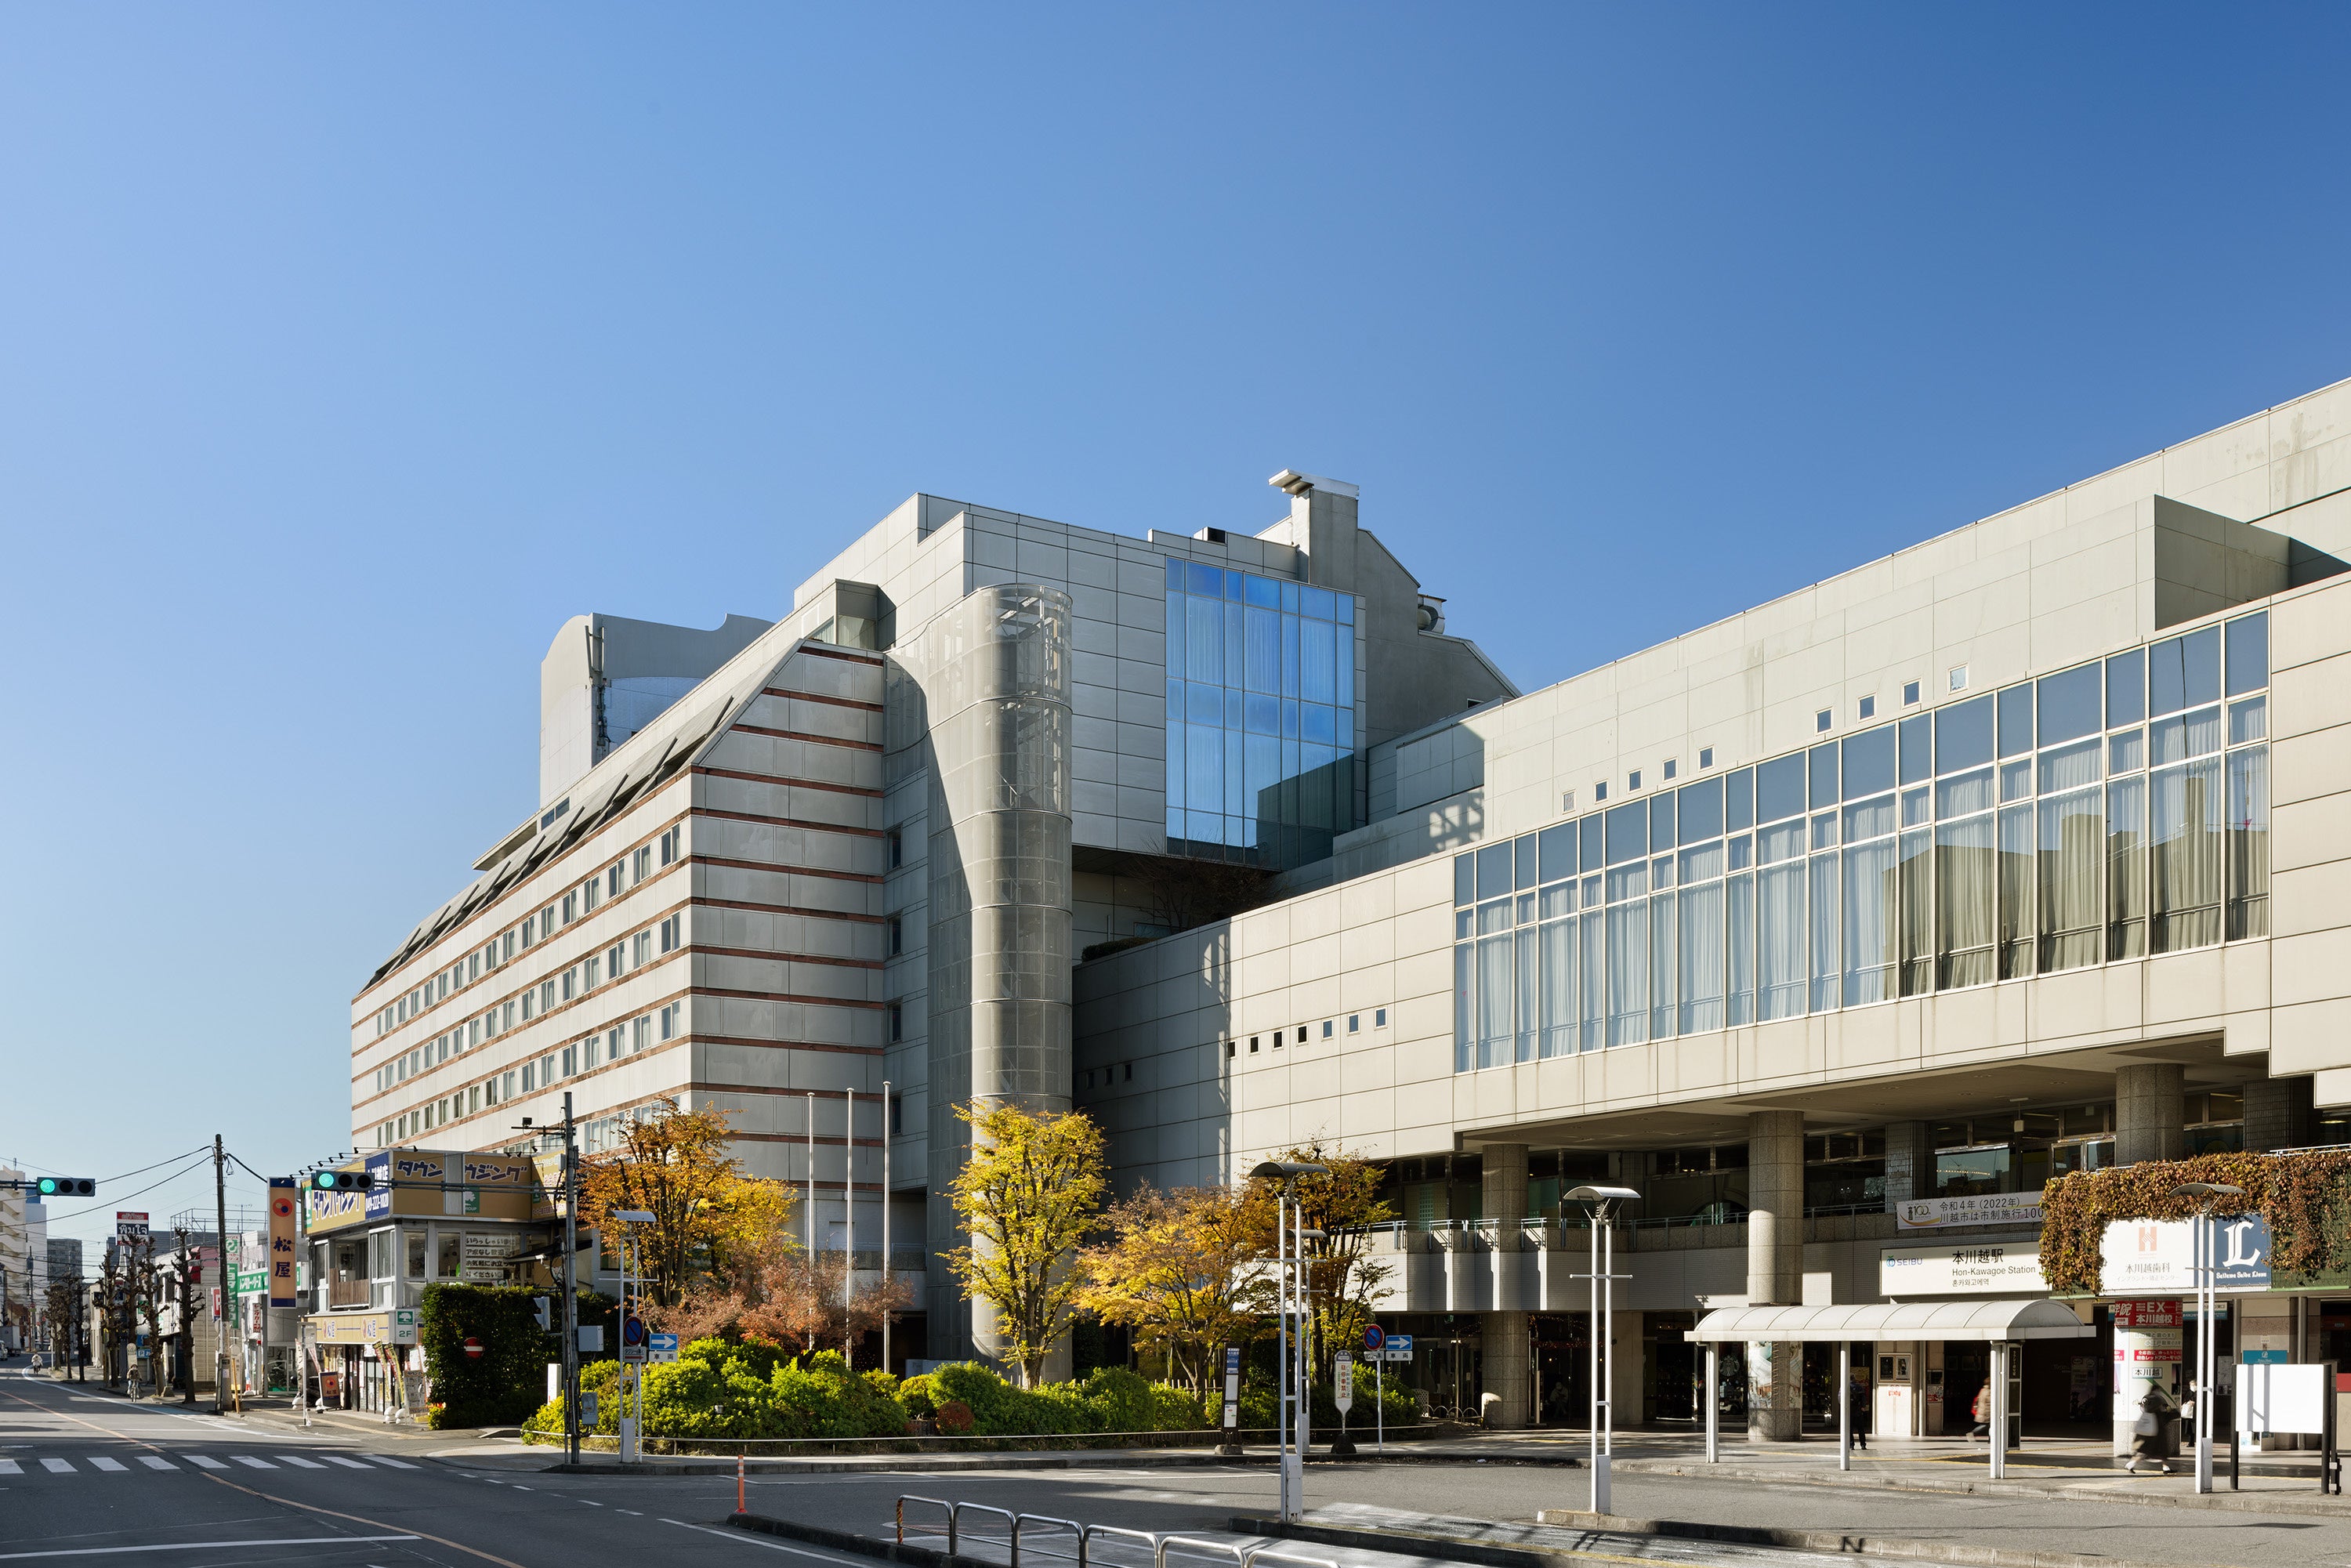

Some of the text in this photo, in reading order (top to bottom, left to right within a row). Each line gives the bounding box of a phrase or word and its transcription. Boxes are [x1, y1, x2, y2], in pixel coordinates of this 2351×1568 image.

[397, 1160, 444, 1177] タウン
[273, 1236, 292, 1278] 松屋
[1896, 1258, 1923, 1266] SEIBU
[1952, 1248, 2004, 1265] 本川越駅
[1952, 1265, 2036, 1277] Hon-Kawagoe Station
[2125, 1262, 2170, 1274] 本川越歯科
[1952, 1278, 1989, 1287] 혼카와고에역
[2147, 1302, 2165, 1312] EX
